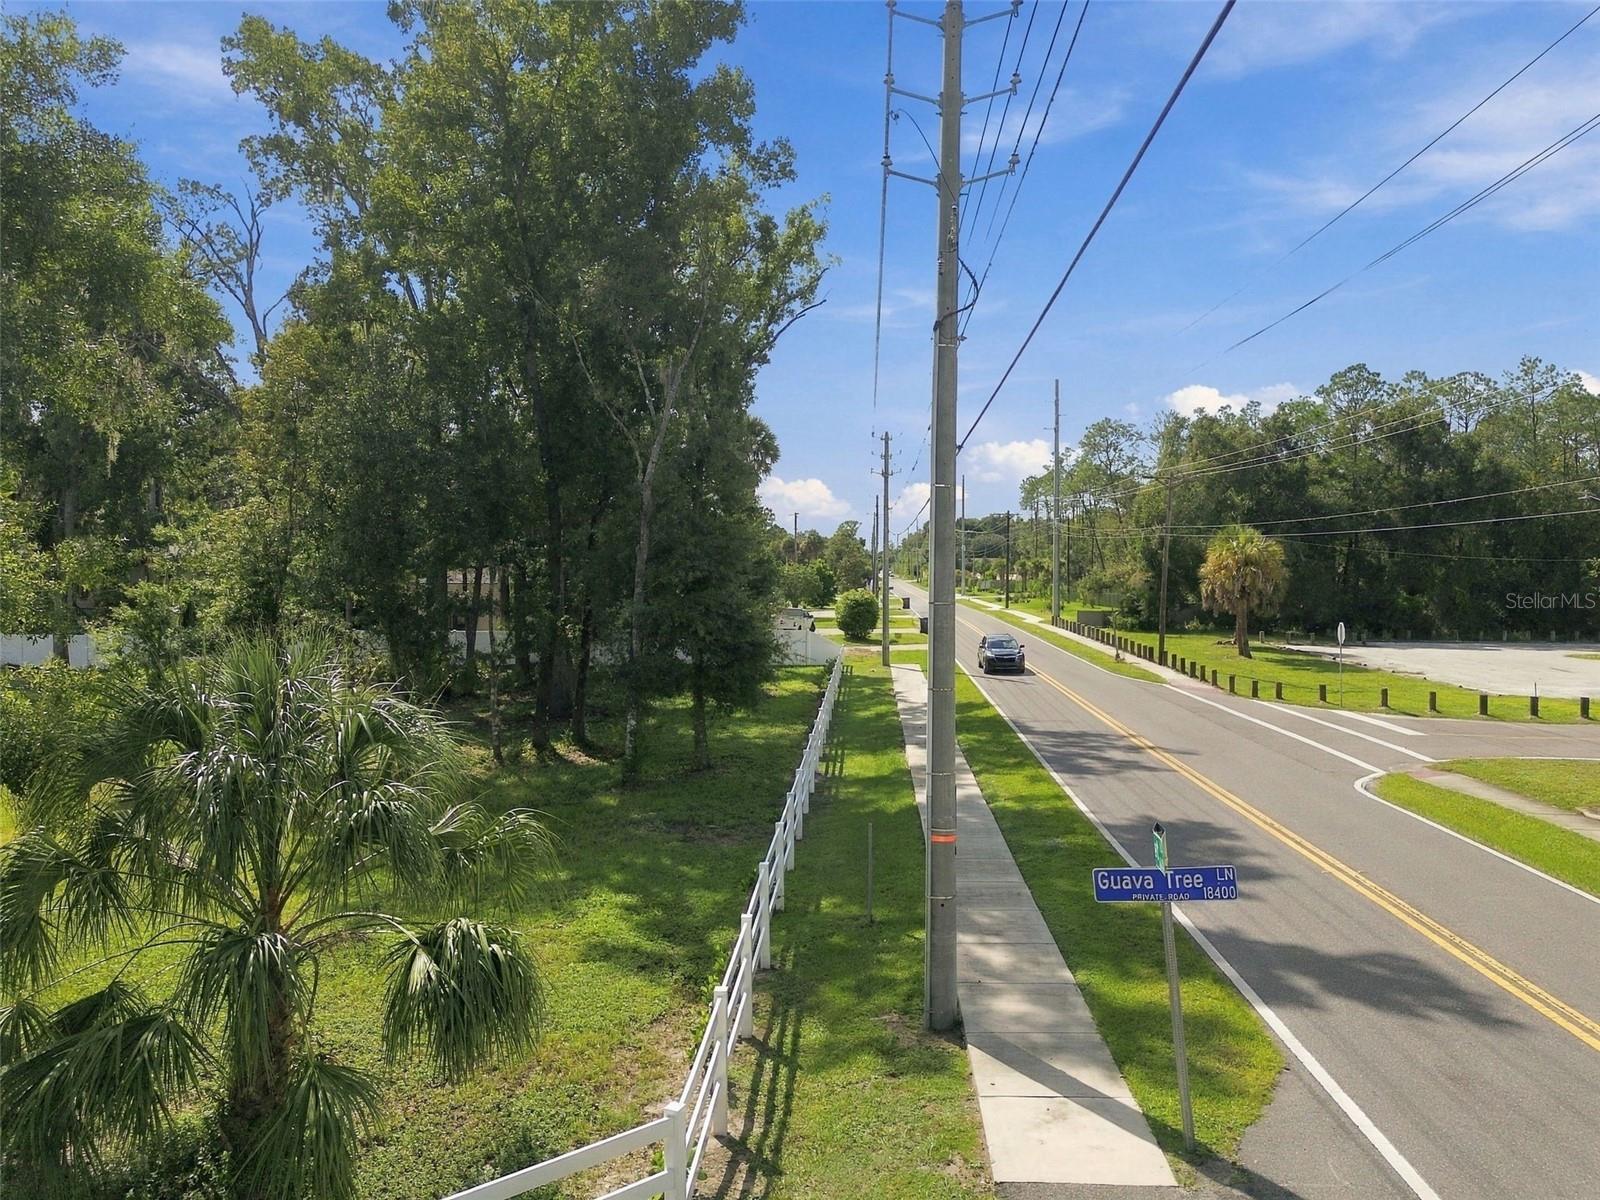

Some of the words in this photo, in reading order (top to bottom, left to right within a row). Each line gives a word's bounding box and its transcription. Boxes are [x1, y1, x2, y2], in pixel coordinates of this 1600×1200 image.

[1098, 872, 1154, 889] Guava
[1165, 871, 1203, 888] Tree
[1216, 868, 1234, 881] LN
[1168, 892, 1190, 900] ROAD
[1203, 886, 1236, 900] 18400
